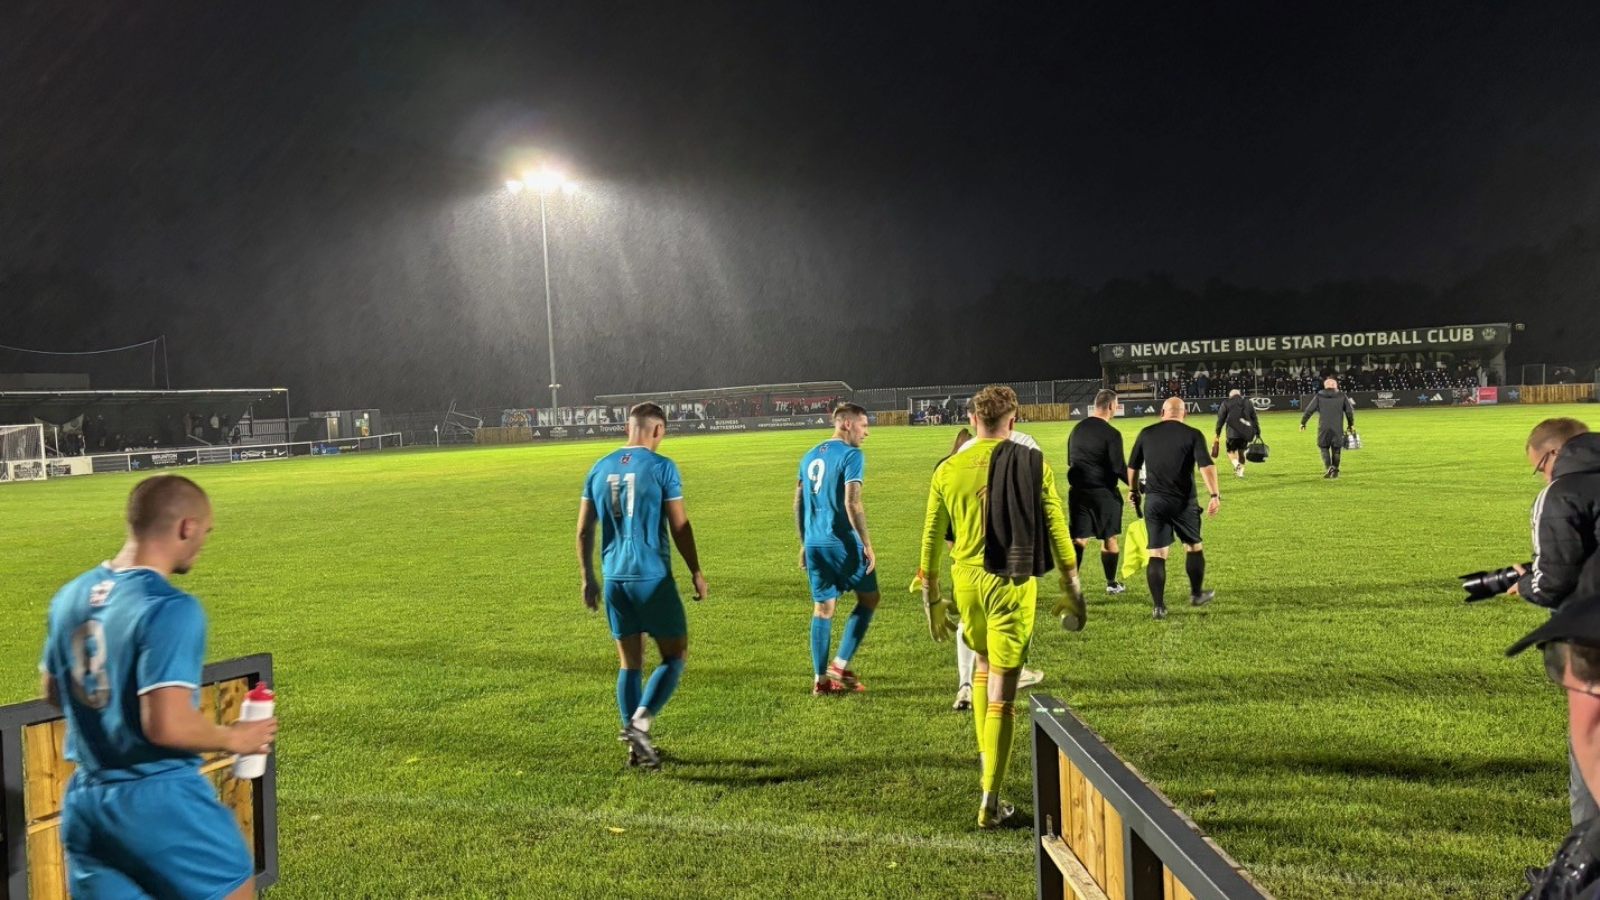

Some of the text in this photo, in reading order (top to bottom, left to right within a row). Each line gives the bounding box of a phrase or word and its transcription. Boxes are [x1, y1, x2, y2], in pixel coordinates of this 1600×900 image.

[1130, 326, 1474, 357] NEWCASTLE BLUE STAR FOOTBALL CLUB
[807, 458, 826, 495] 9
[606, 473, 636, 518] 11
